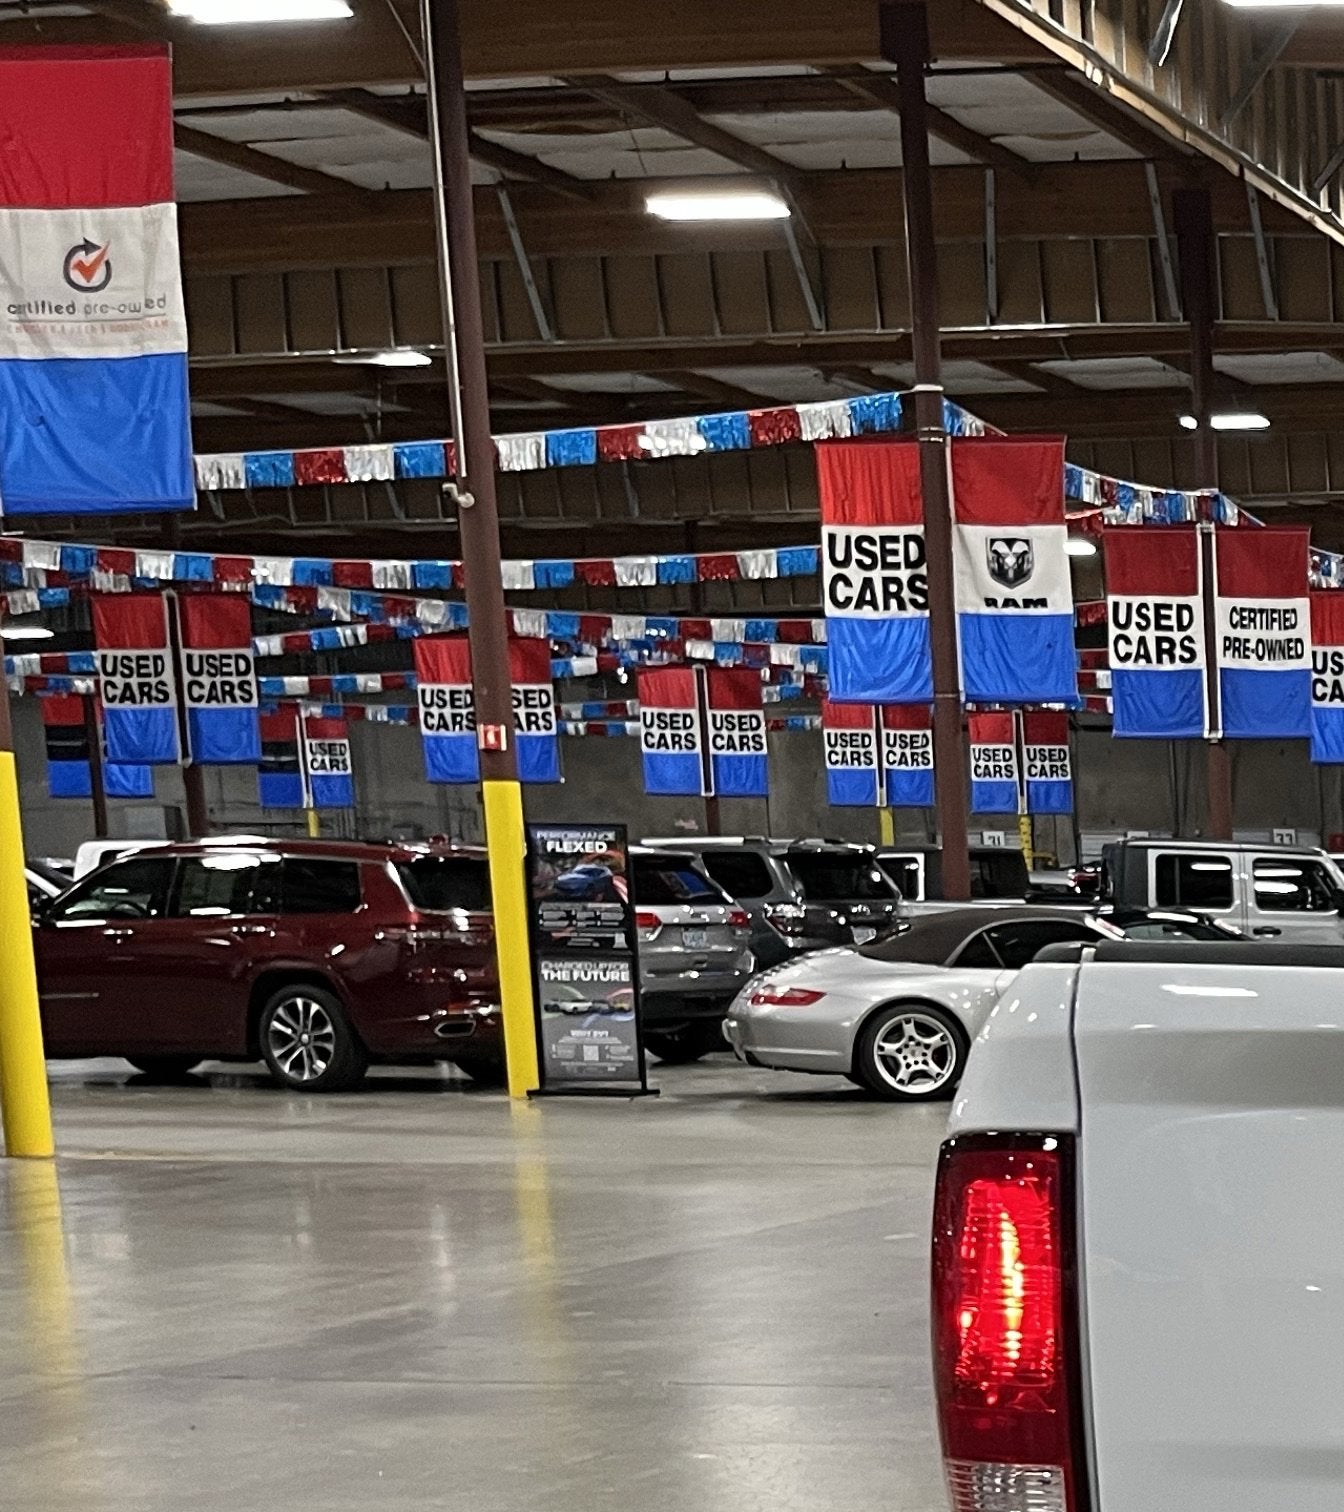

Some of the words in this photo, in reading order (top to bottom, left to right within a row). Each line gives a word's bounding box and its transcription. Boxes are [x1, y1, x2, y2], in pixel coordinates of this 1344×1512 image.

[7, 299, 77, 315] ctified
[83, 292, 167, 317] pre-owed
[828, 533, 927, 572] USED
[829, 573, 929, 611] CARS
[984, 597, 1049, 609] RAM
[1112, 601, 1194, 631] USED
[1229, 606, 1298, 631] CERTIFIED
[1113, 633, 1197, 664] CARS
[1223, 635, 1305, 661] PRE-OWNED
[101, 654, 165, 678] USED
[186, 654, 252, 678] USED
[104, 680, 170, 704] CARS
[187, 680, 253, 704] CARS
[421, 689, 474, 709] USED
[511, 689, 551, 709] SED
[423, 711, 476, 731] CARS
[512, 711, 553, 731] ARS
[643, 712, 694, 730] USED
[712, 713, 761, 732] USED
[309, 742, 347, 756] USED
[644, 732, 697, 750] CARS
[712, 733, 764, 751] CARS
[827, 732, 872, 749] USED
[886, 733, 930, 749] USED
[827, 750, 874, 766] CARS
[886, 750, 931, 766] CARS
[973, 747, 1013, 763] USED
[1026, 747, 1068, 763] USED
[310, 758, 348, 772] CARS
[973, 764, 1014, 778] CARS
[1027, 764, 1069, 778] CARS
[546, 840, 608, 853] FLEXED
[541, 970, 571, 982] THE
[572, 970, 630, 982] FUTURE
